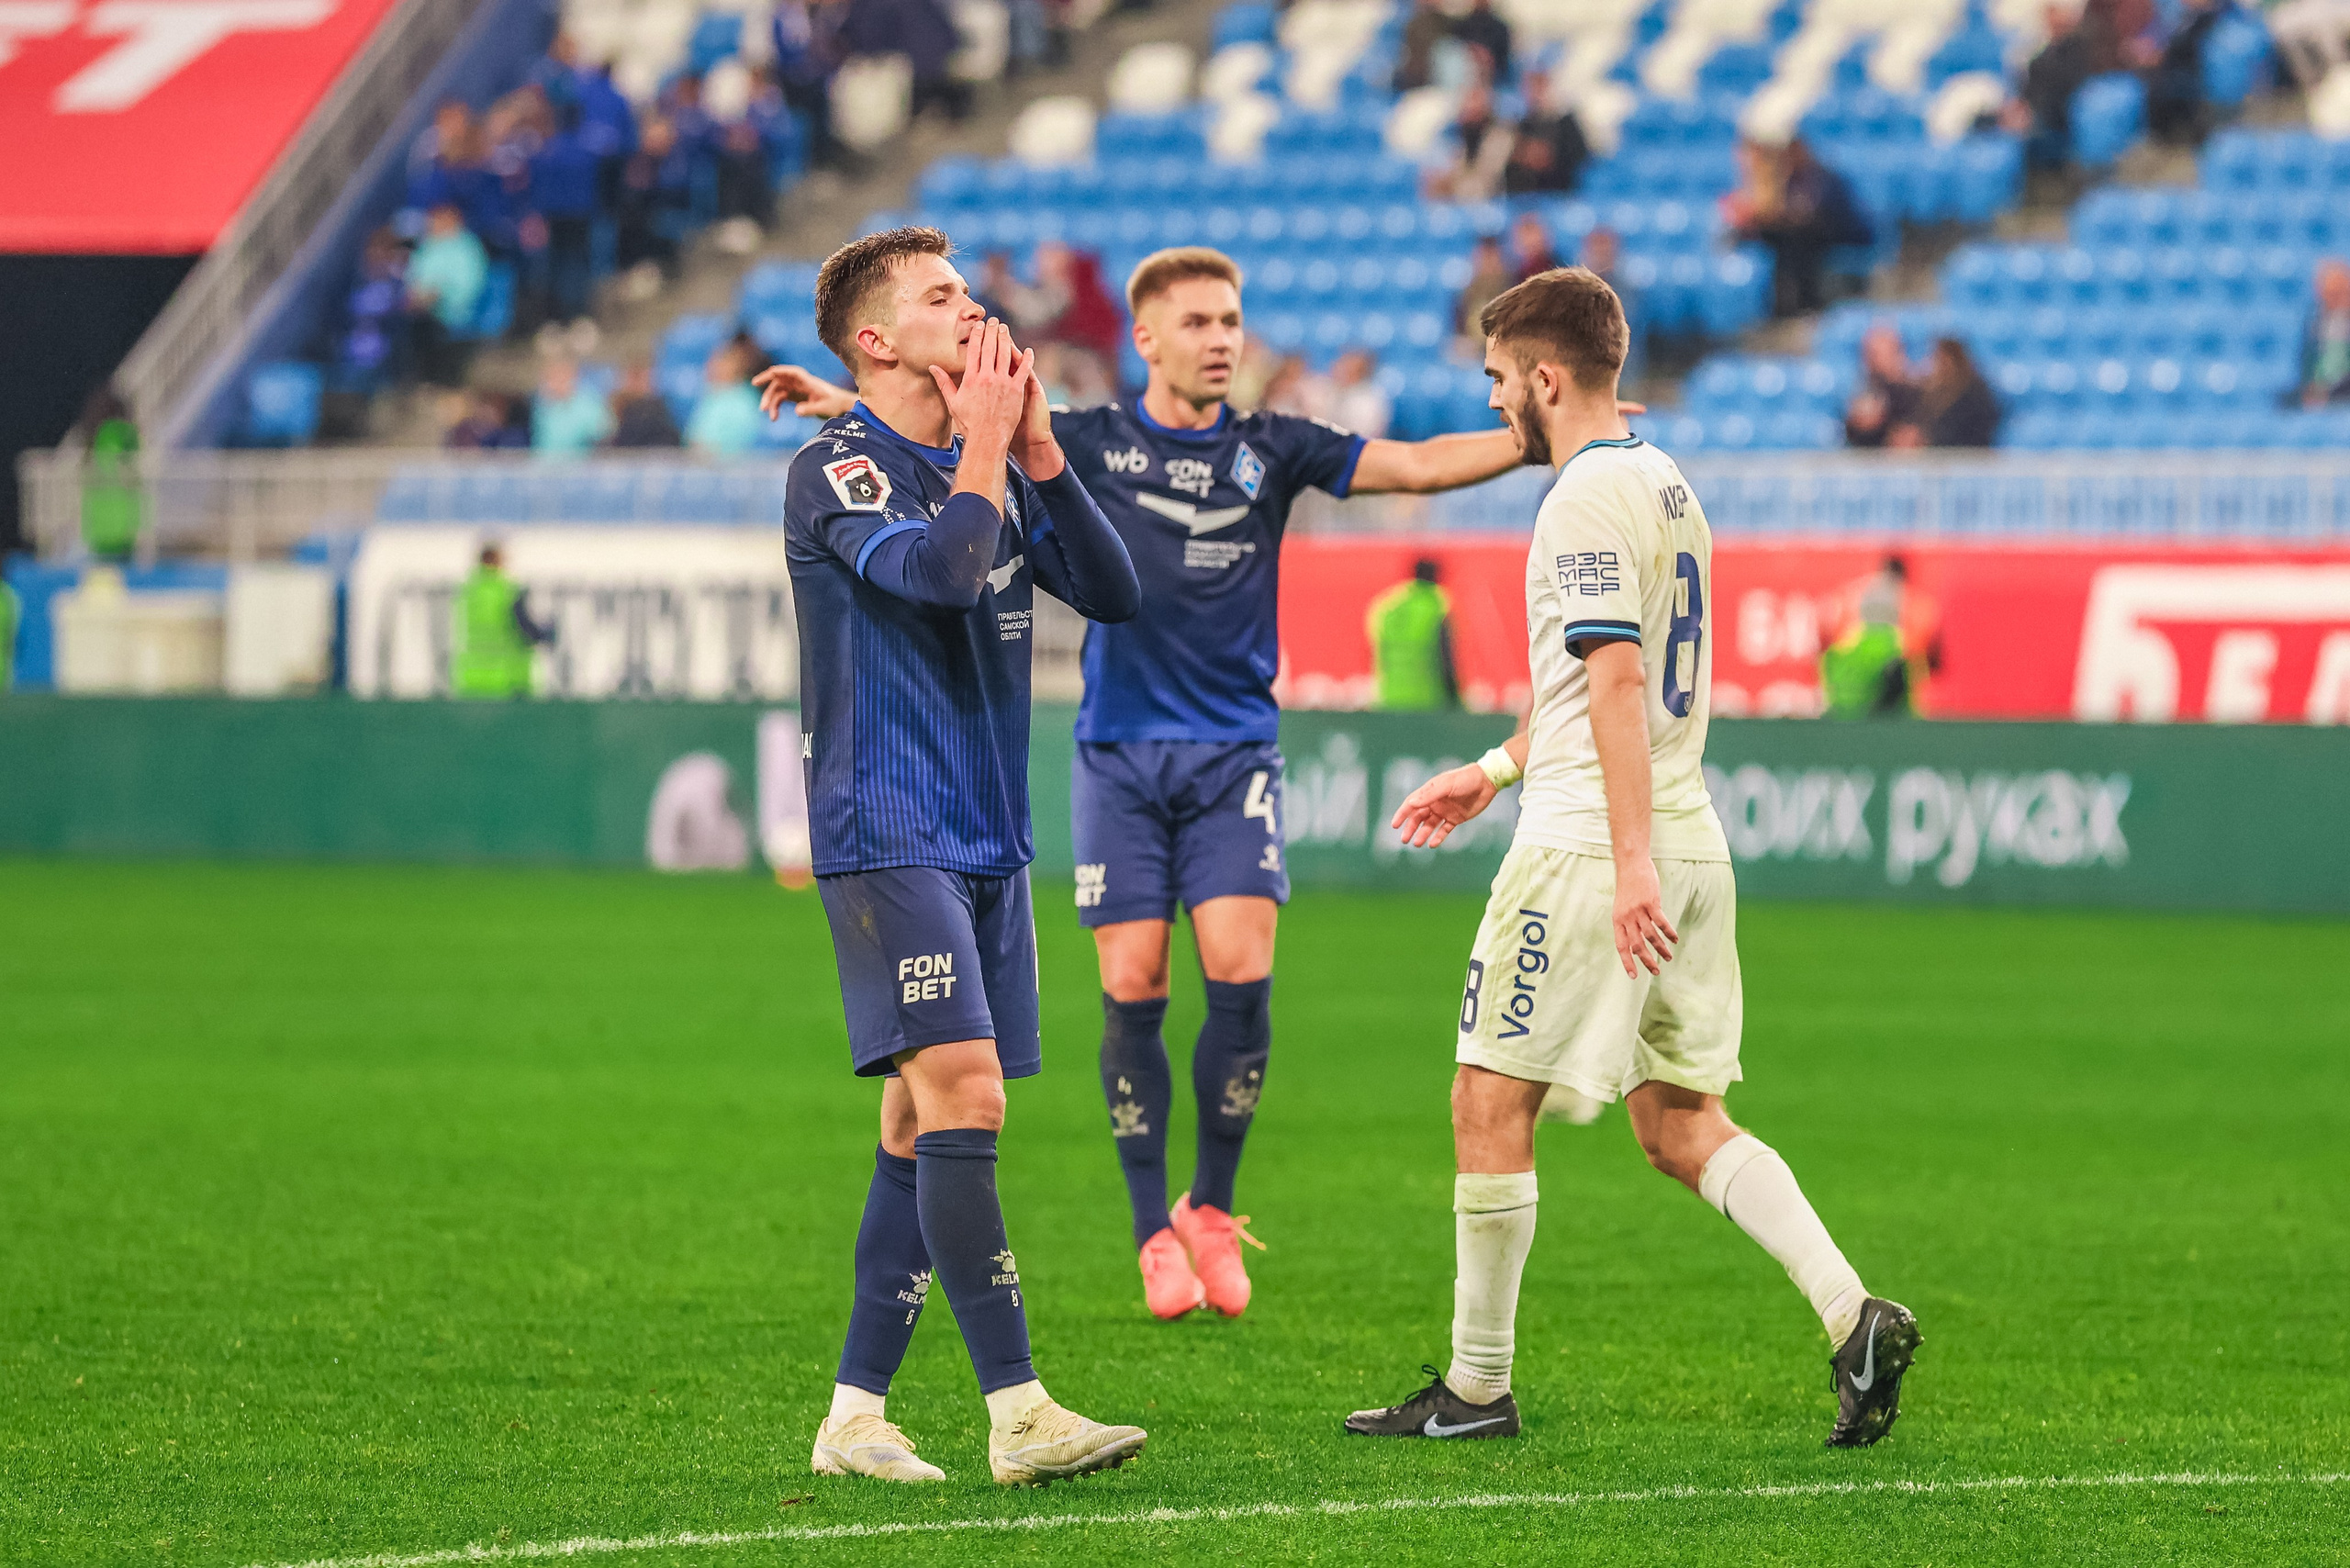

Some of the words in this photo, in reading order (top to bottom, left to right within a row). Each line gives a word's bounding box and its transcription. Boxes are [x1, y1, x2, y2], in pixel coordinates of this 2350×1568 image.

[834, 429, 867, 439] KELME
[1556, 552, 1618, 568] ВЭД
[1558, 567, 1619, 583] МАС
[1561, 583, 1620, 597] ТЕР
[1662, 552, 1703, 718] 8
[1243, 770, 1277, 834] 4
[898, 952, 953, 981] FON
[1497, 909, 1550, 1040] Vorgol
[902, 976, 957, 1004] BET
[1460, 958, 1484, 1034] 8
